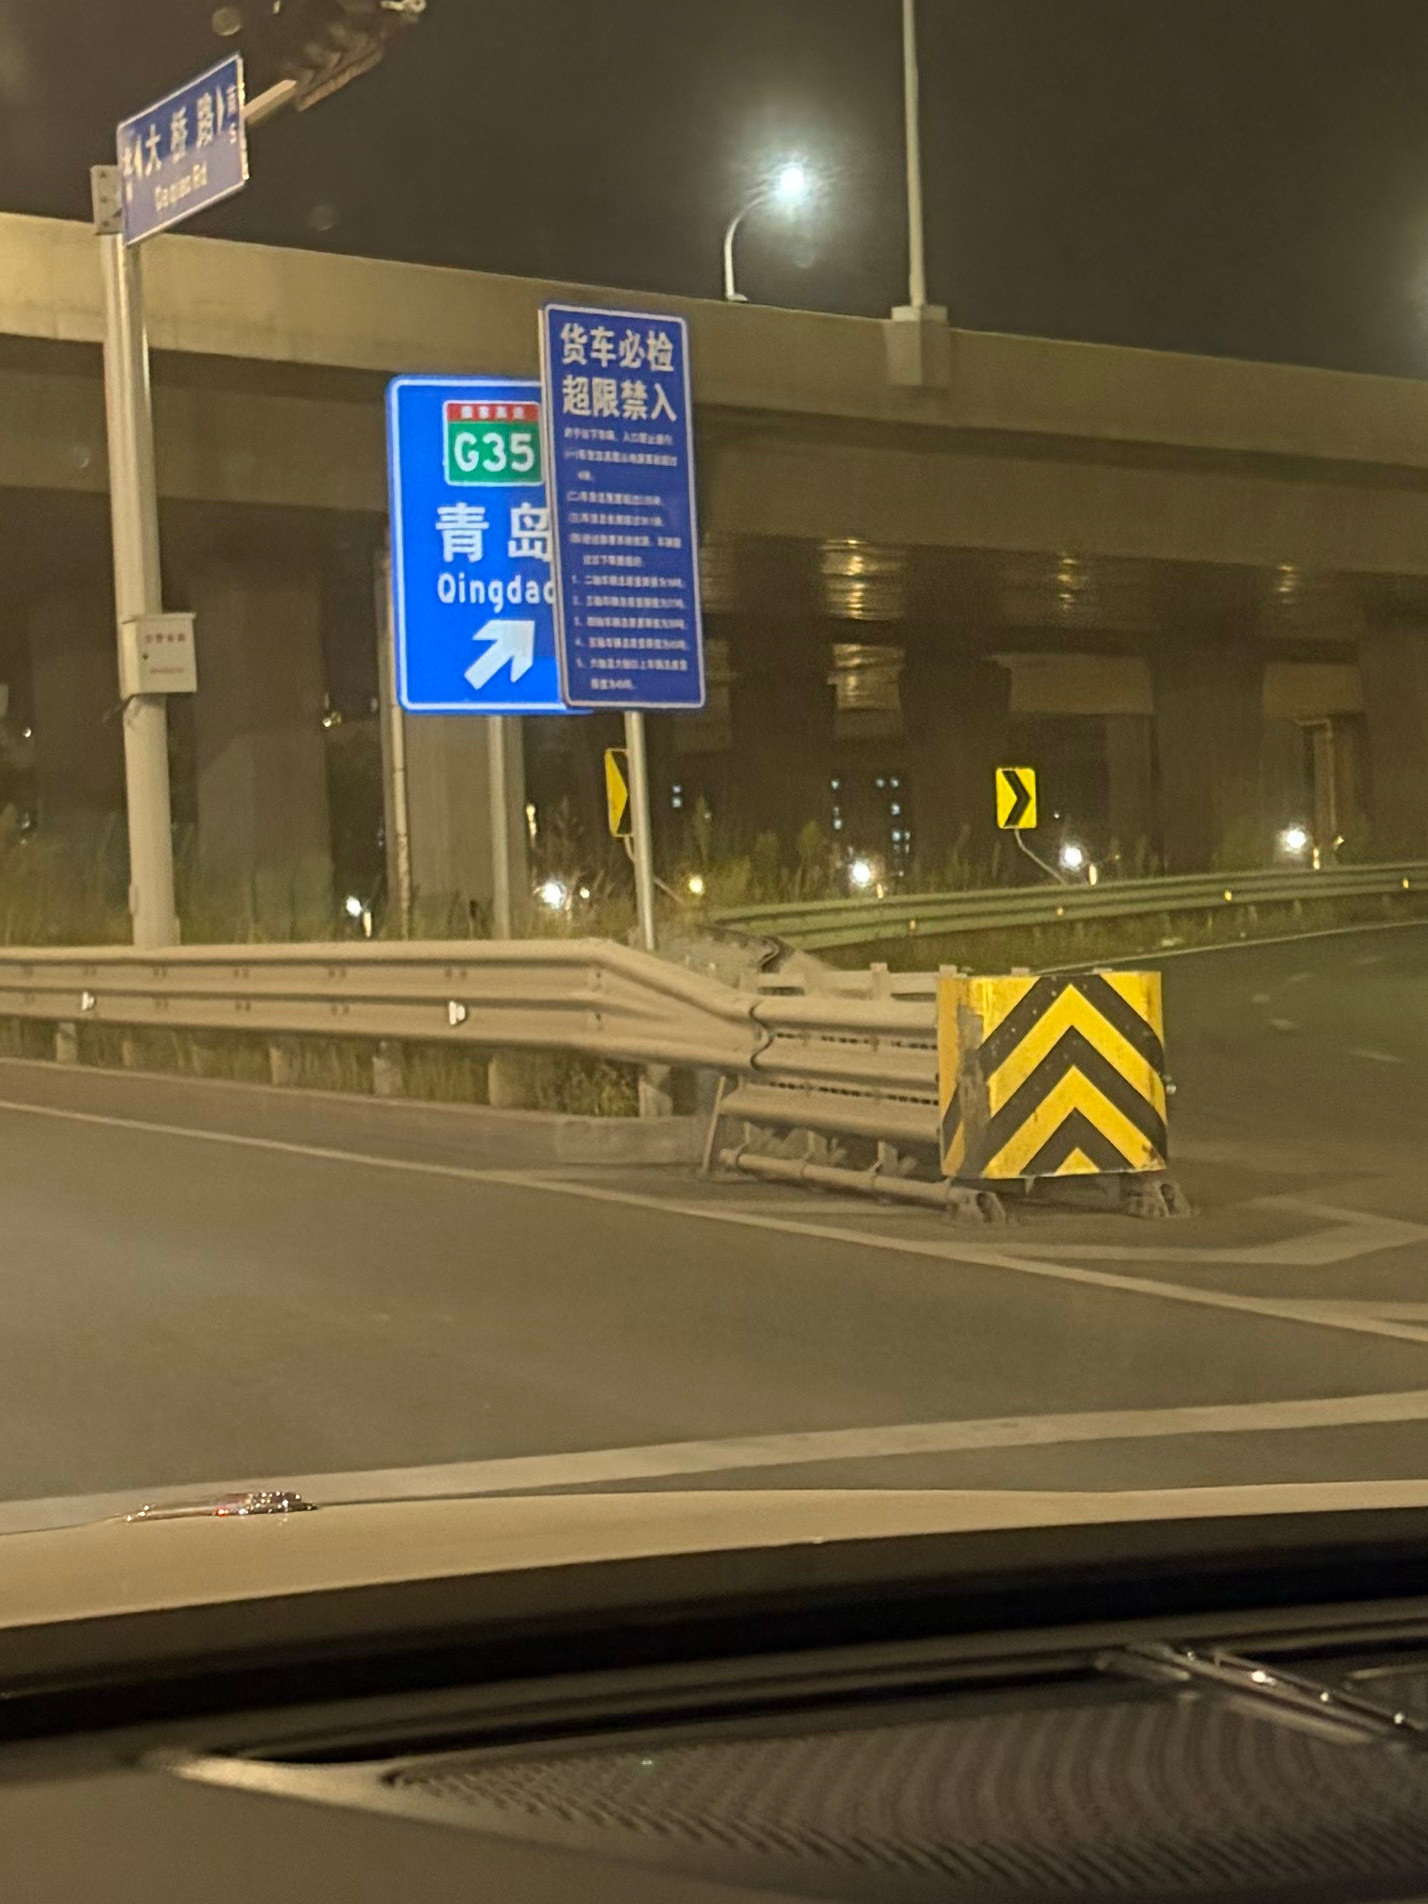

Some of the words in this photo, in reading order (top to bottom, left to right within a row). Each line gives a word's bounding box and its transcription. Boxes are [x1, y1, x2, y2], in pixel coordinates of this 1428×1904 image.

[560, 322, 674, 372] 货车必检
[562, 374, 677, 423] 超限禁入
[454, 431, 535, 473] G35
[435, 501, 552, 563] 青岛
